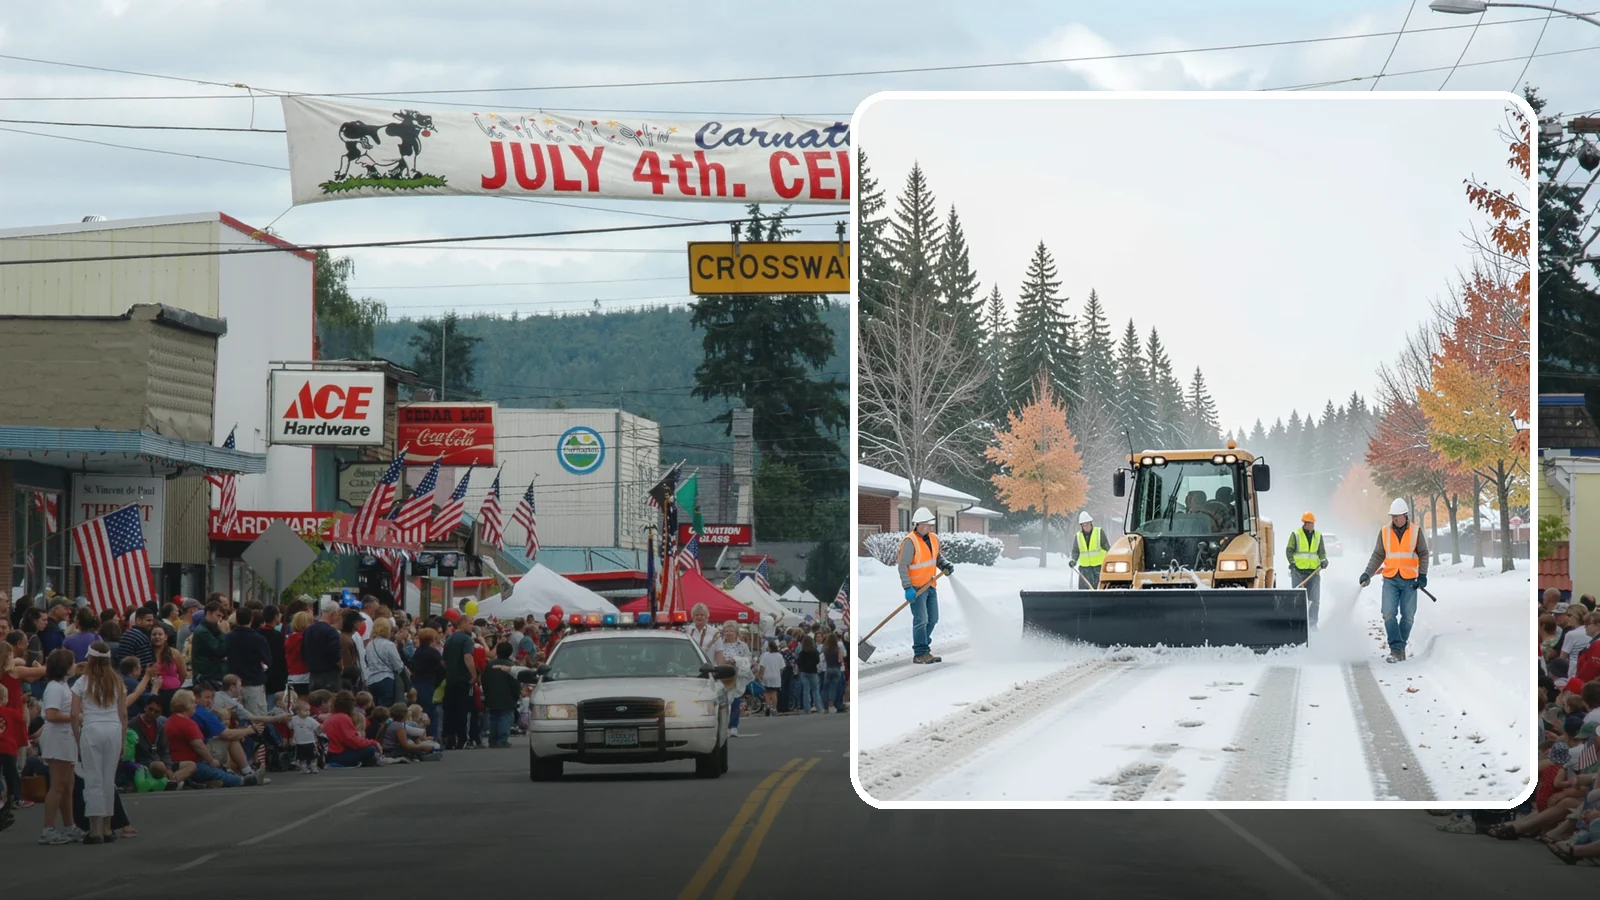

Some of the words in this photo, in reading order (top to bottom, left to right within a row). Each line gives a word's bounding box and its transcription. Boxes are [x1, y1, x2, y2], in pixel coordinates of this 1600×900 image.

[481, 141, 605, 193] JULY
[632, 150, 747, 199] 4th.
[697, 254, 850, 280] CROSSWA
[283, 380, 373, 420] ACE
[405, 409, 452, 422] CEDAR
[284, 421, 371, 437] Hardware
[416, 428, 477, 447] Coca-Cola
[83, 484, 92, 494] St.
[95, 484, 124, 495] Vincent
[126, 485, 136, 495] de
[137, 485, 155, 495] Paul
[688, 526, 742, 535] CRNATION
[699, 535, 731, 544] GLASS
